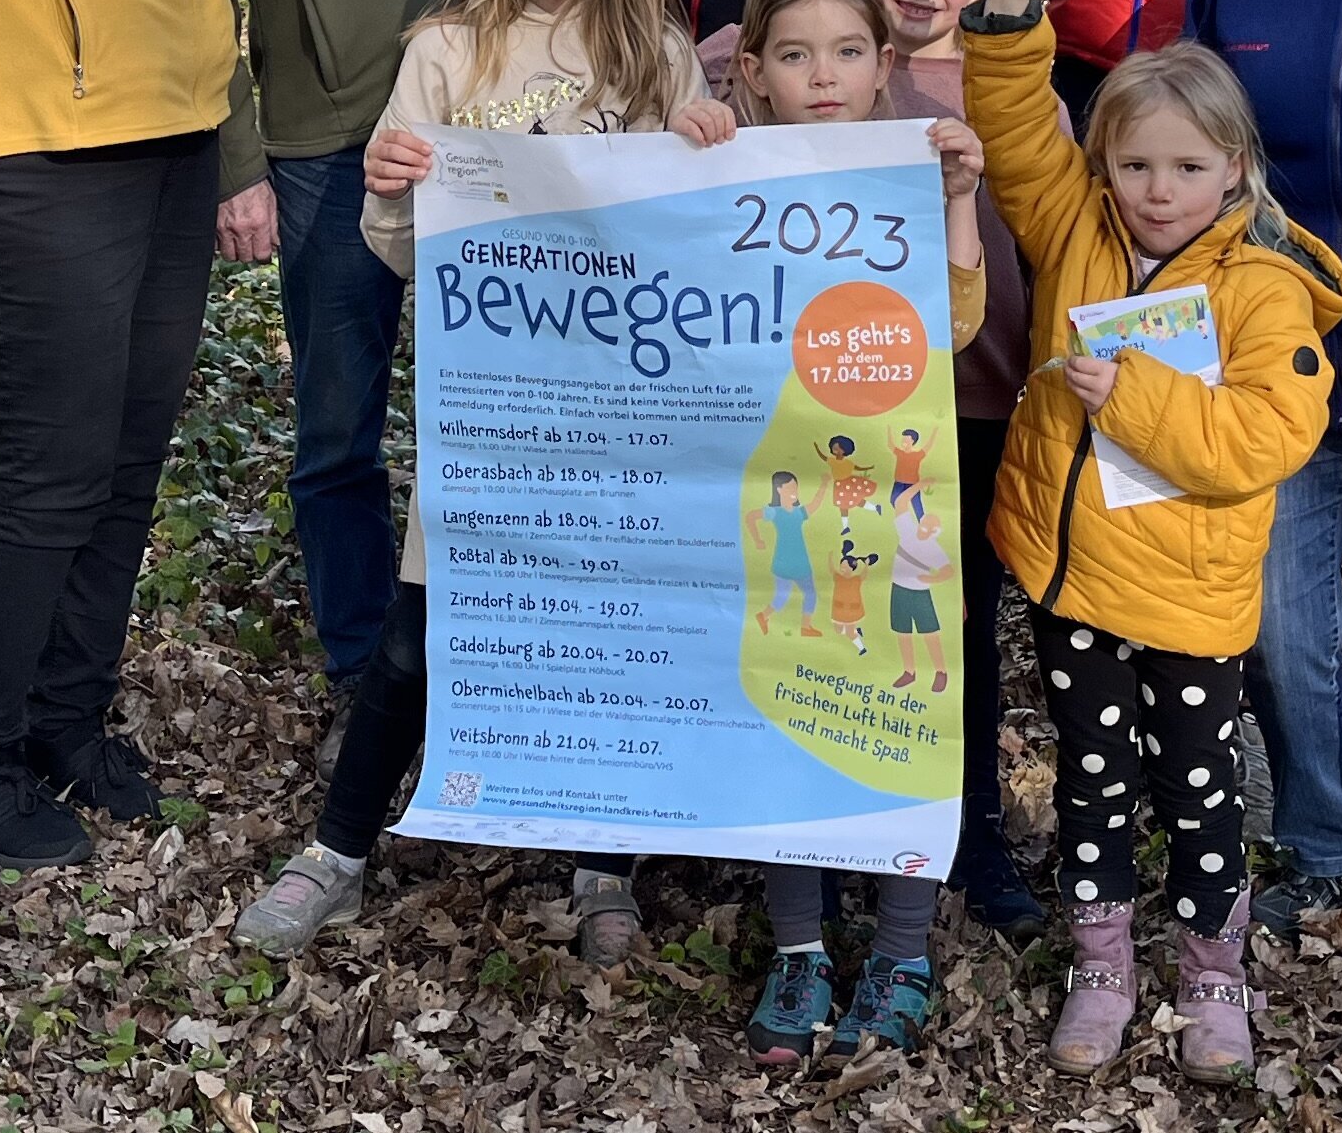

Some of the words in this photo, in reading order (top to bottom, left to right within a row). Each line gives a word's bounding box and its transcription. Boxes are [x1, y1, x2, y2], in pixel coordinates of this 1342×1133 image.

[446, 153, 504, 169] Gesundheits
[448, 166, 478, 179] region
[502, 229, 542, 242] GESUND
[544, 232, 567, 245] VON
[568, 235, 597, 248] 0-100
[732, 194, 910, 272] 2023
[462, 240, 636, 280] GENERATIONEN
[436, 264, 784, 379] Bewegen!
[807, 329, 841, 349] Los
[837, 352, 853, 364] ab
[856, 352, 883, 364] dem
[439, 369, 455, 379] Ein
[457, 370, 513, 383] kostenloses
[515, 374, 612, 392] Bewegungsangebot
[613, 384, 626, 392] an
[629, 383, 647, 393] der
[649, 383, 690, 394] frischen
[692, 385, 714, 394] Luft
[716, 384, 731, 395] für
[734, 385, 754, 395] alle
[810, 364, 913, 384] 17.04.2023
[439, 384, 505, 397] Interessierten
[508, 390, 526, 399] von
[528, 390, 555, 401] 0-100
[556, 393, 592, 405] Jahren.
[594, 395, 605, 406] Es
[607, 397, 628, 407] sind
[631, 397, 659, 407] keine
[662, 398, 735, 409] Vorkenntnisse
[737, 399, 762, 409] oder
[439, 398, 495, 414] Anmeldung
[497, 402, 556, 416] erforderlich.
[559, 406, 595, 418] Einfach
[597, 411, 630, 420] vorbei
[633, 412, 678, 422] kommen
[681, 413, 701, 422] und
[703, 414, 765, 424] mitmachen!
[439, 420, 539, 442] Wilhermsdorf
[544, 426, 562, 443] ab
[567, 431, 611, 445] 17.04.
[628, 433, 674, 446] 17.07.
[501, 443, 517, 452] Uhr
[523, 445, 548, 454] Wiese
[442, 461, 533, 482] Oberasbach
[538, 465, 555, 483] ab
[560, 468, 604, 484] 18.04.
[622, 469, 668, 485] 18.07.
[507, 486, 522, 495] Uhr
[528, 487, 583, 498] Rathausplatz
[600, 489, 636, 499] Brunnen
[443, 510, 530, 530] Langenzenn
[535, 509, 553, 528] ab
[558, 512, 602, 530] 18.04.
[619, 515, 665, 532] 18.07.
[508, 531, 524, 540] Uhr
[574, 533, 588, 542] auf
[589, 534, 603, 543] der
[648, 537, 675, 546] neben
[449, 547, 495, 564] Roßtal
[500, 549, 517, 566] ab
[522, 554, 565, 569] 19.04.
[581, 559, 625, 574] 19.07.
[517, 571, 532, 579] Uhr
[701, 582, 740, 592] Erholung
[450, 591, 514, 611] Zirndorf
[519, 593, 536, 611] ab
[541, 597, 583, 615] 19.04.
[600, 600, 644, 619] 19.07.
[519, 615, 534, 624] Uhr
[617, 622, 644, 632] neben
[645, 623, 665, 633] dem
[666, 625, 708, 635] Spielplatz
[450, 636, 534, 662] Cadolzburg
[538, 640, 556, 659] ab
[561, 645, 608, 662] 20.04.
[625, 649, 674, 665] 20.07.
[450, 657, 499, 669] donnerstags
[524, 661, 540, 671] Uhr
[546, 664, 587, 675] Spielplatz
[451, 678, 573, 703] Obermichelbach
[578, 688, 595, 705] ab
[600, 692, 648, 709] 20.04.
[665, 697, 714, 713] 20.07.
[796, 664, 875, 704] Bewegung
[877, 690, 895, 706] an
[900, 693, 928, 715] der
[451, 701, 501, 714] donnerstags
[525, 705, 541, 715] Uhr
[547, 707, 572, 717] Wiese
[574, 709, 587, 718] bei
[589, 710, 603, 719] der
[684, 717, 694, 726] SC
[696, 718, 766, 731] Obermichelbach
[775, 682, 839, 715] frischen
[843, 704, 877, 728] Luft
[882, 712, 913, 739] hält
[916, 726, 939, 746] fit
[450, 726, 529, 747] Veitsbronn
[534, 729, 552, 749] ab
[556, 734, 601, 753] 21.04.
[617, 739, 663, 756] 21.07.
[788, 717, 817, 737] und
[820, 726, 869, 752] macht
[872, 739, 912, 765] Spaß.
[503, 751, 518, 760] Uhr
[524, 753, 549, 763] Wiese
[550, 754, 575, 764] hinter
[577, 755, 596, 766] dem
[485, 784, 520, 795] Weitere
[522, 786, 544, 797] Infos
[546, 788, 564, 798] und
[566, 790, 601, 801] Kontakt
[603, 793, 628, 803] unter
[775, 849, 847, 864] Landkreis
[848, 855, 887, 868] Fürth
